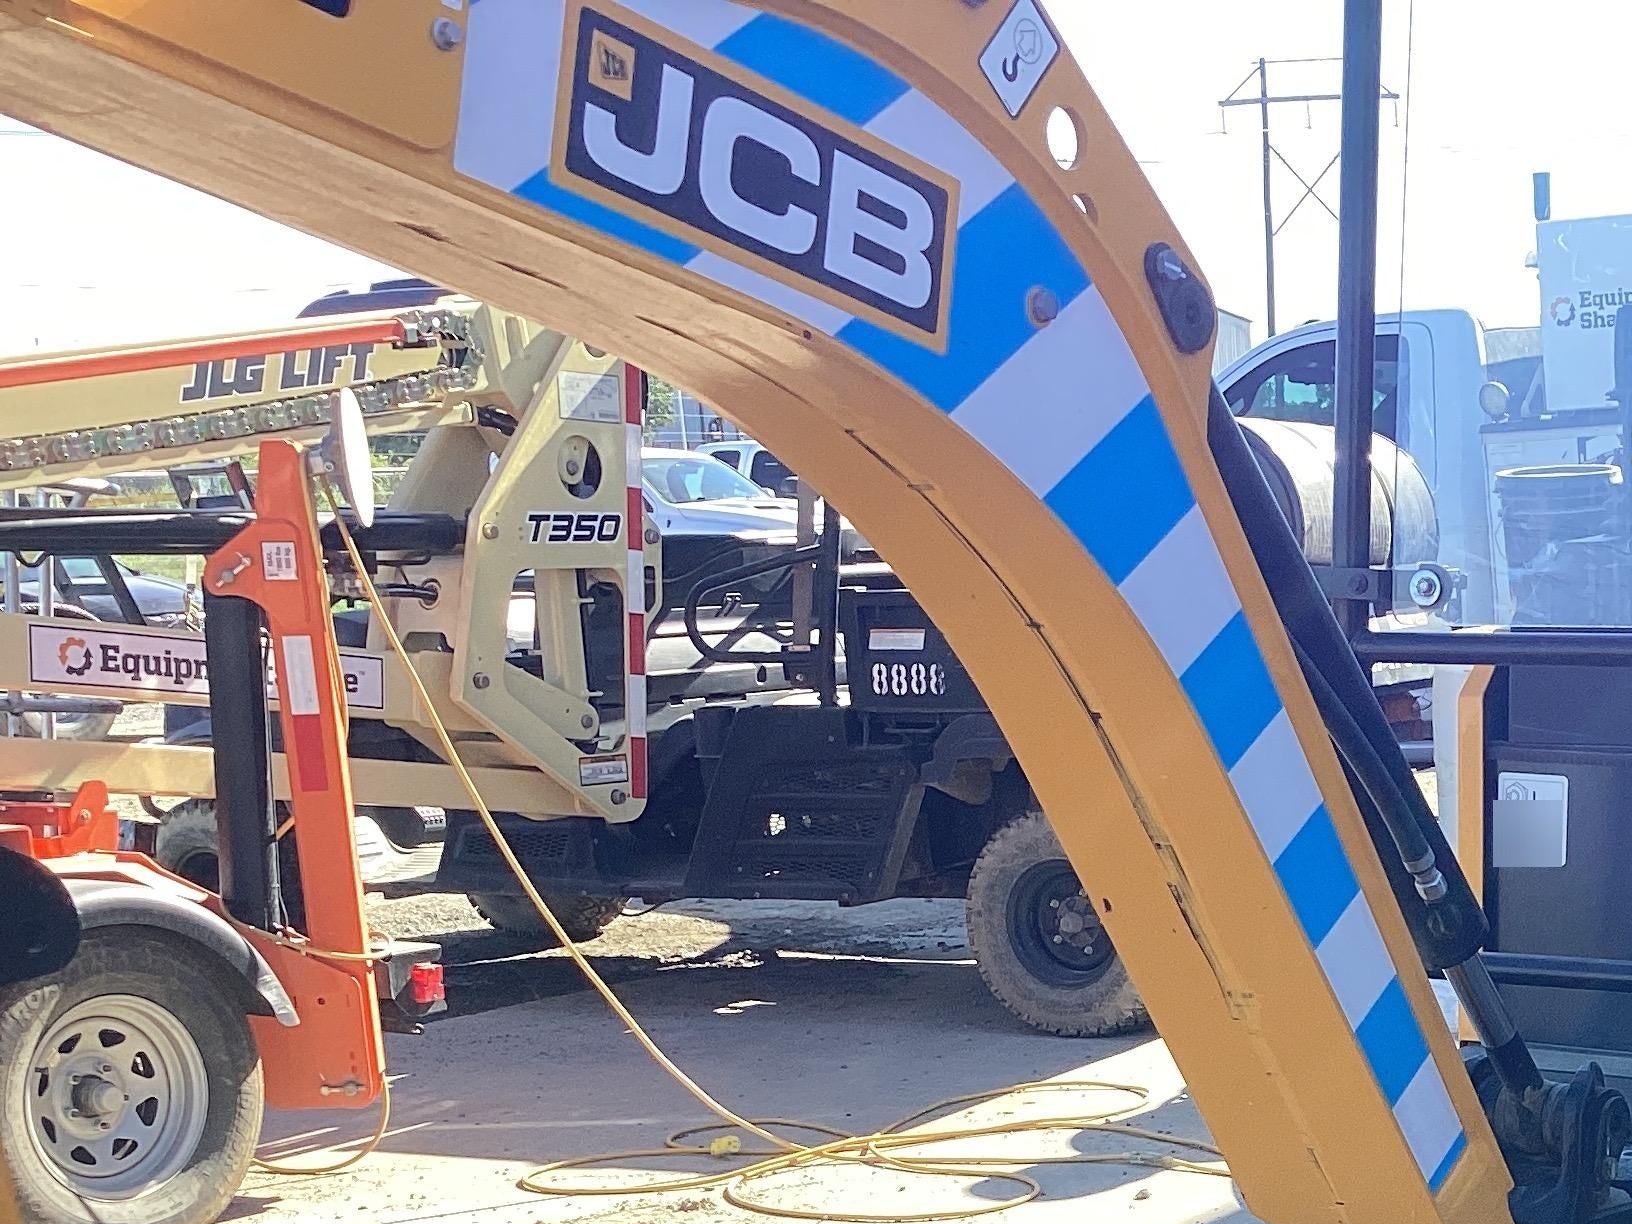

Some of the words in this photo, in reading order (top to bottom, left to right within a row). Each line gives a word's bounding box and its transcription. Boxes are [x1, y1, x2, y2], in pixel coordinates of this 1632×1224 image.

[581, 62, 935, 309] JCB
[181, 354, 267, 403] JLG
[279, 343, 375, 391] LIFT
[528, 513, 621, 543] T350
